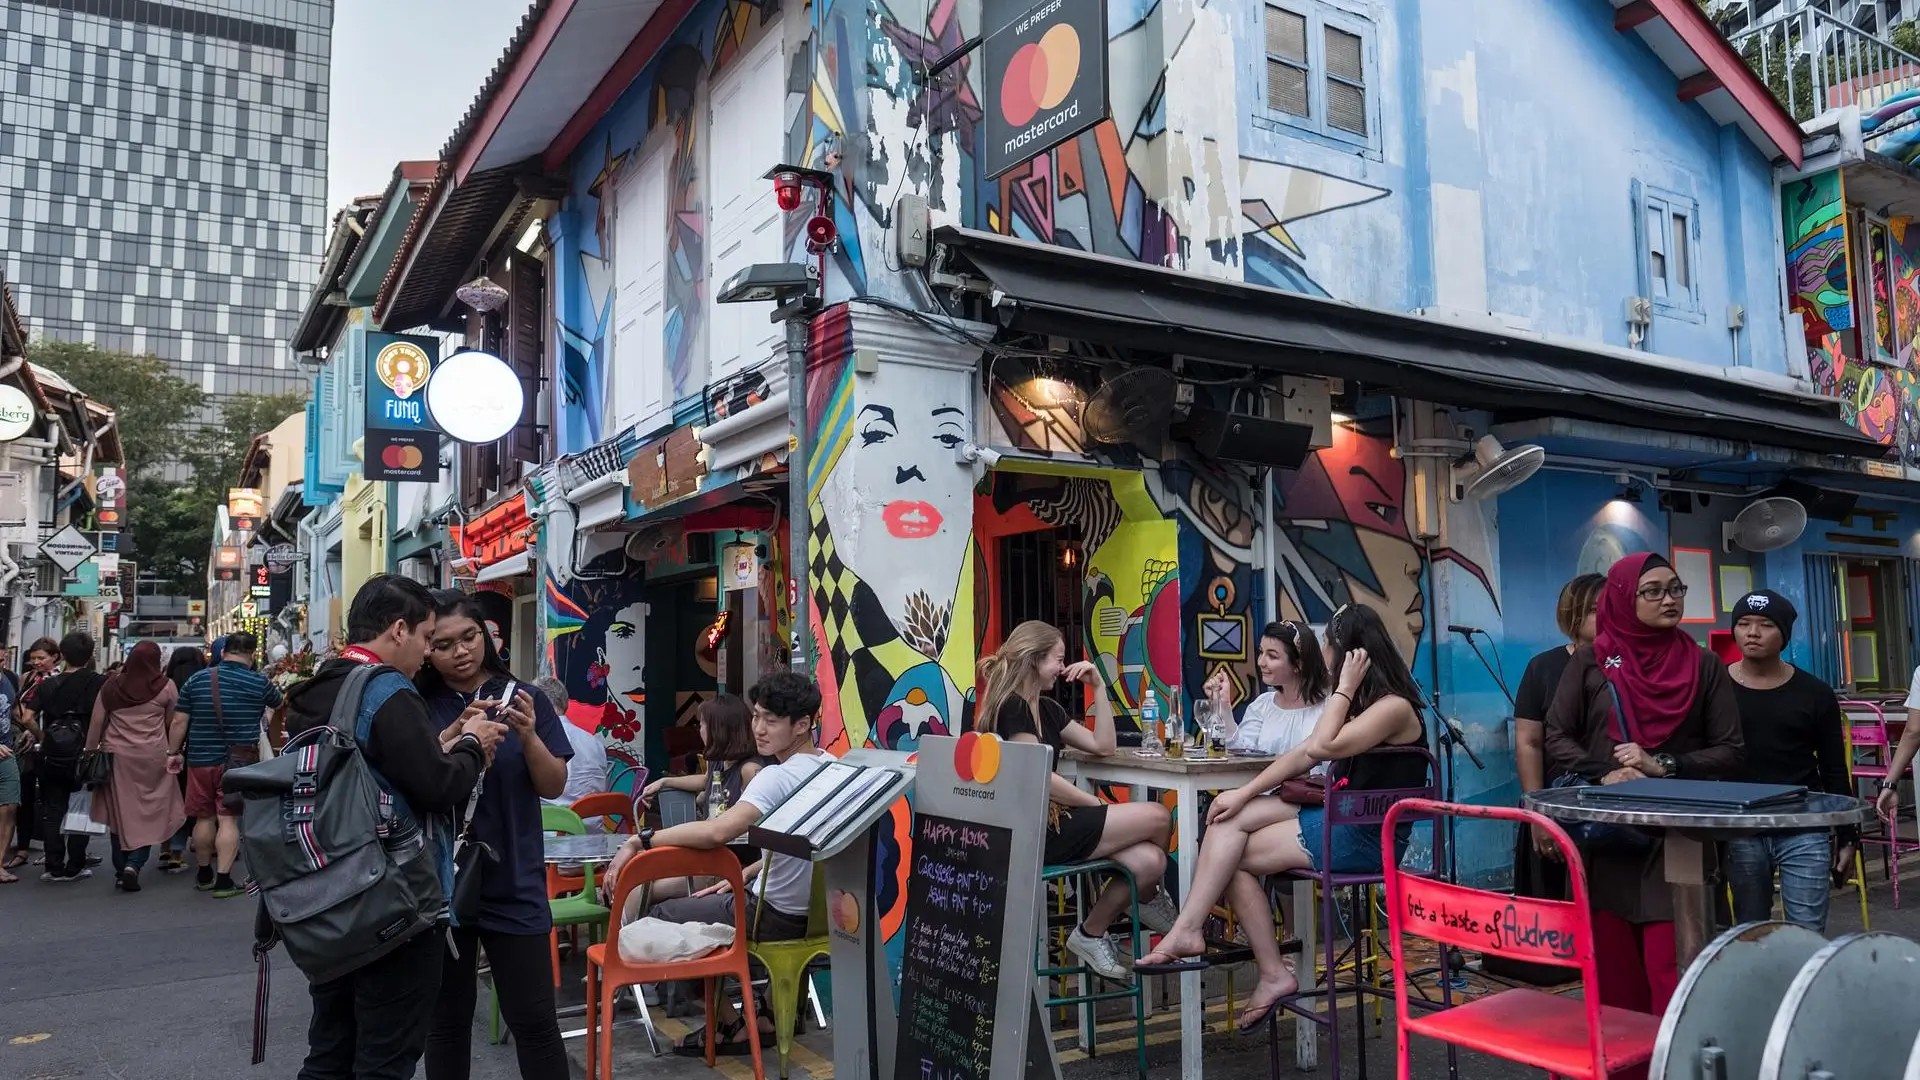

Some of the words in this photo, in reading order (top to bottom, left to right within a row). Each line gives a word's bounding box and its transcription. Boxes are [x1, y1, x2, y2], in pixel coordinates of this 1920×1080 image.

[1015, 19, 1029, 36] WE
[1030, 0, 1062, 26] PREFER
[1004, 99, 1079, 155] mastercard
[0, 407, 30, 422] berg
[386, 399, 422, 424] FUNQ
[383, 468, 421, 476] mastercard
[348, 650, 370, 662] Canon
[952, 786, 996, 800] mastercard
[923, 819, 959, 845] HAPPY
[960, 826, 989, 850] HOUR
[1429, 910, 1437, 922] a
[1441, 903, 1479, 933] taste
[1484, 910, 1502, 949] of
[1502, 904, 1576, 958] Audrey
